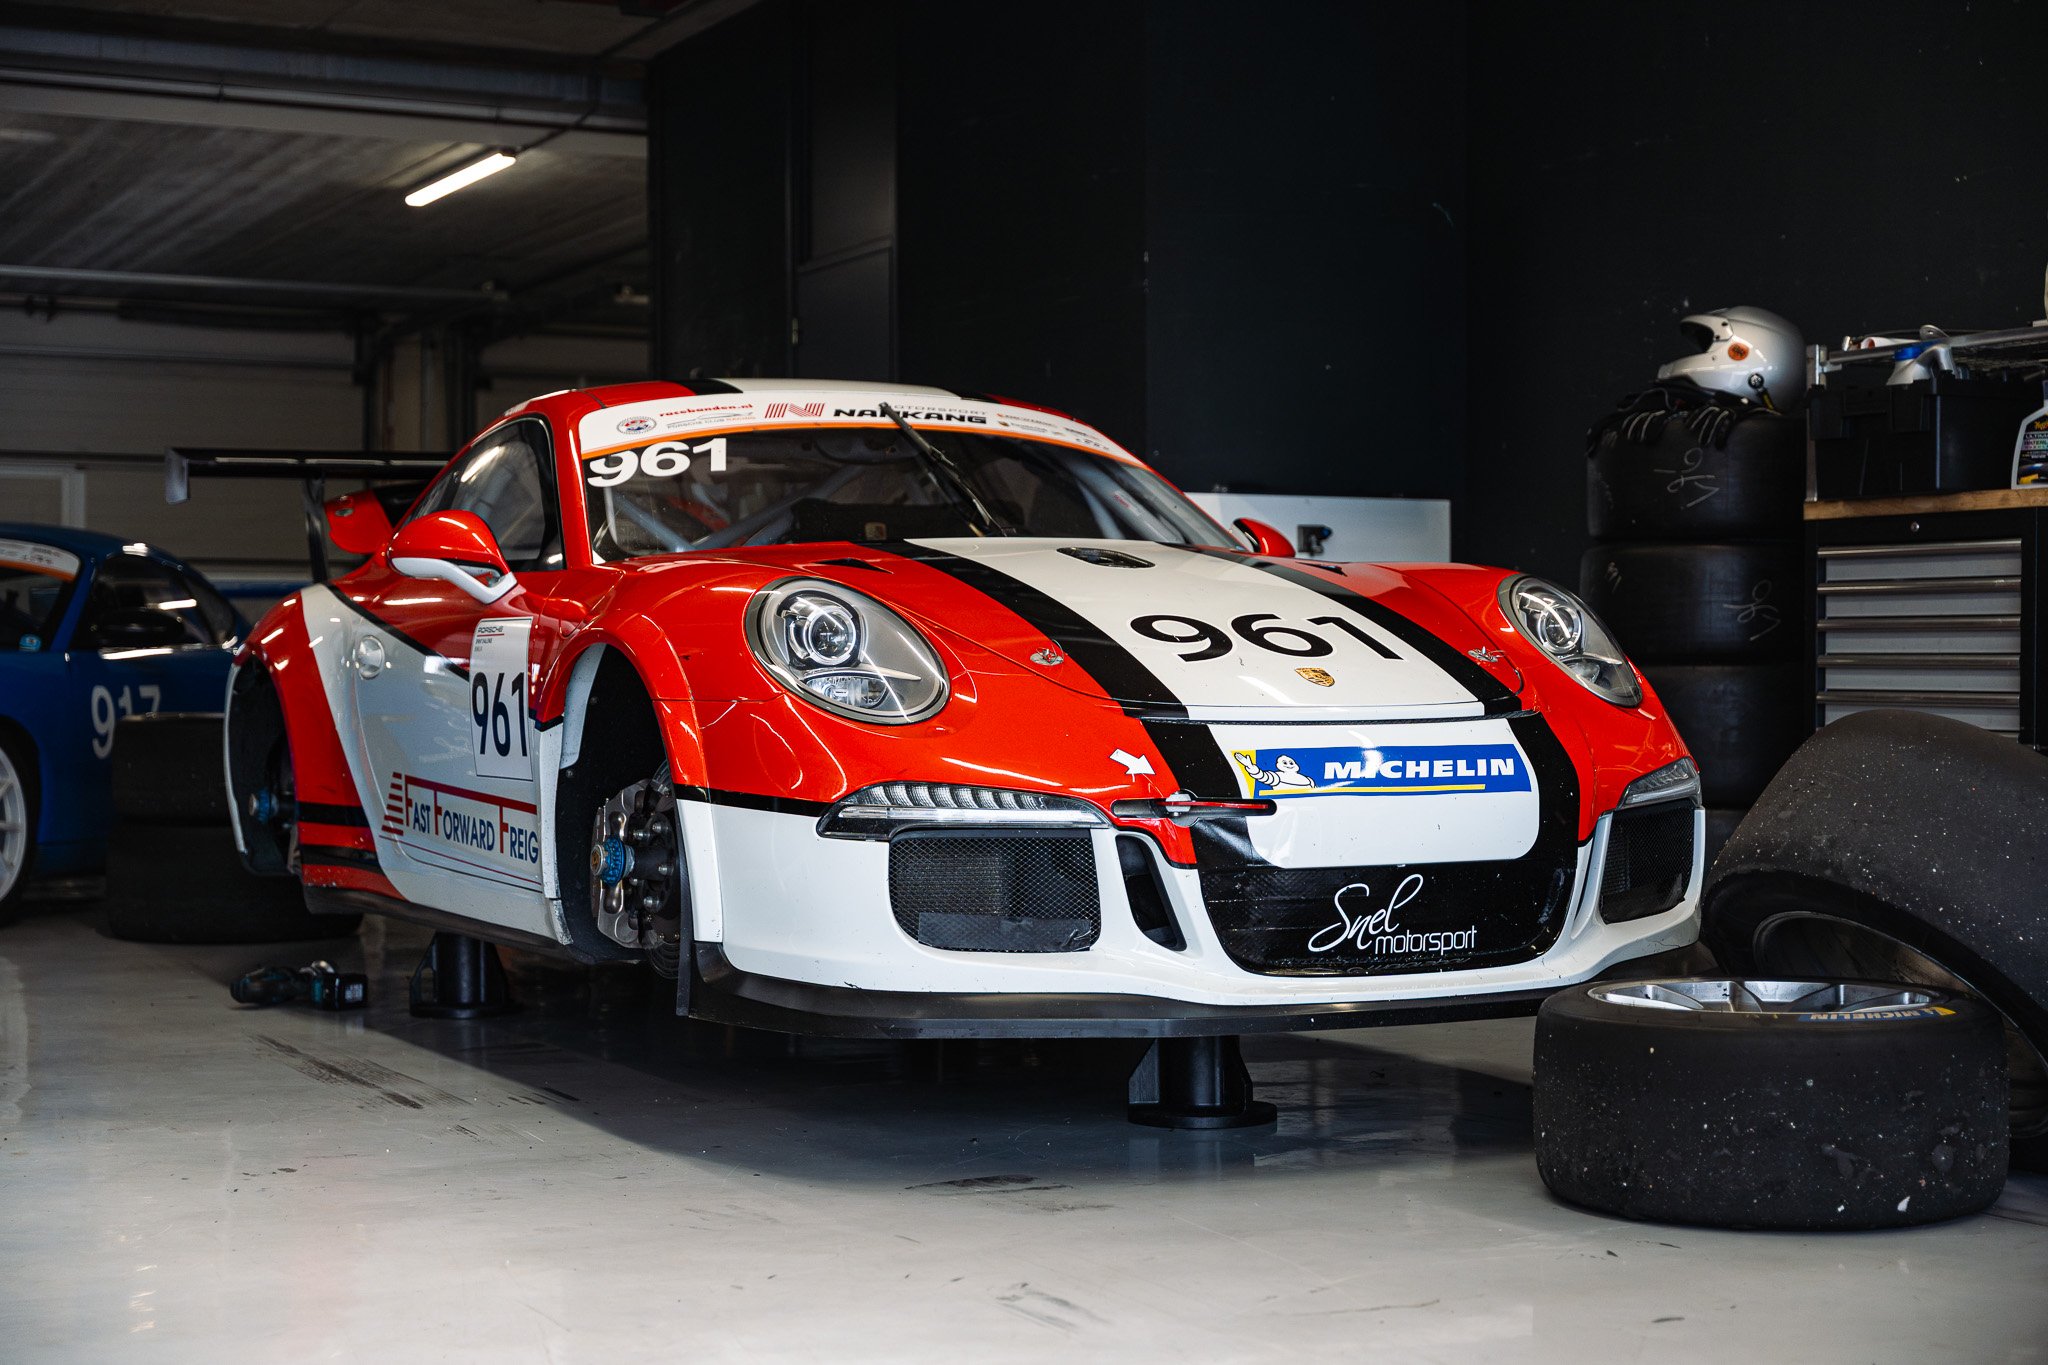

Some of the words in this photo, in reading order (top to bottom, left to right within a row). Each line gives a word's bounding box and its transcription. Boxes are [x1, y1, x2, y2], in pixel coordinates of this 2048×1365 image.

[893, 404, 988, 416] OTORSPORT
[587, 438, 727, 488] 961
[477, 625, 504, 634] PORSCHE
[1130, 613, 1404, 663] 961
[471, 671, 528, 757] 961
[1323, 757, 1515, 780] MICHELIN
[404, 775, 431, 834] FAST
[433, 784, 496, 852] FORWARD
[1307, 873, 1424, 953] Snel
[1374, 924, 1478, 956] motorsport
[1810, 1006, 1921, 1020] MICHELIN
